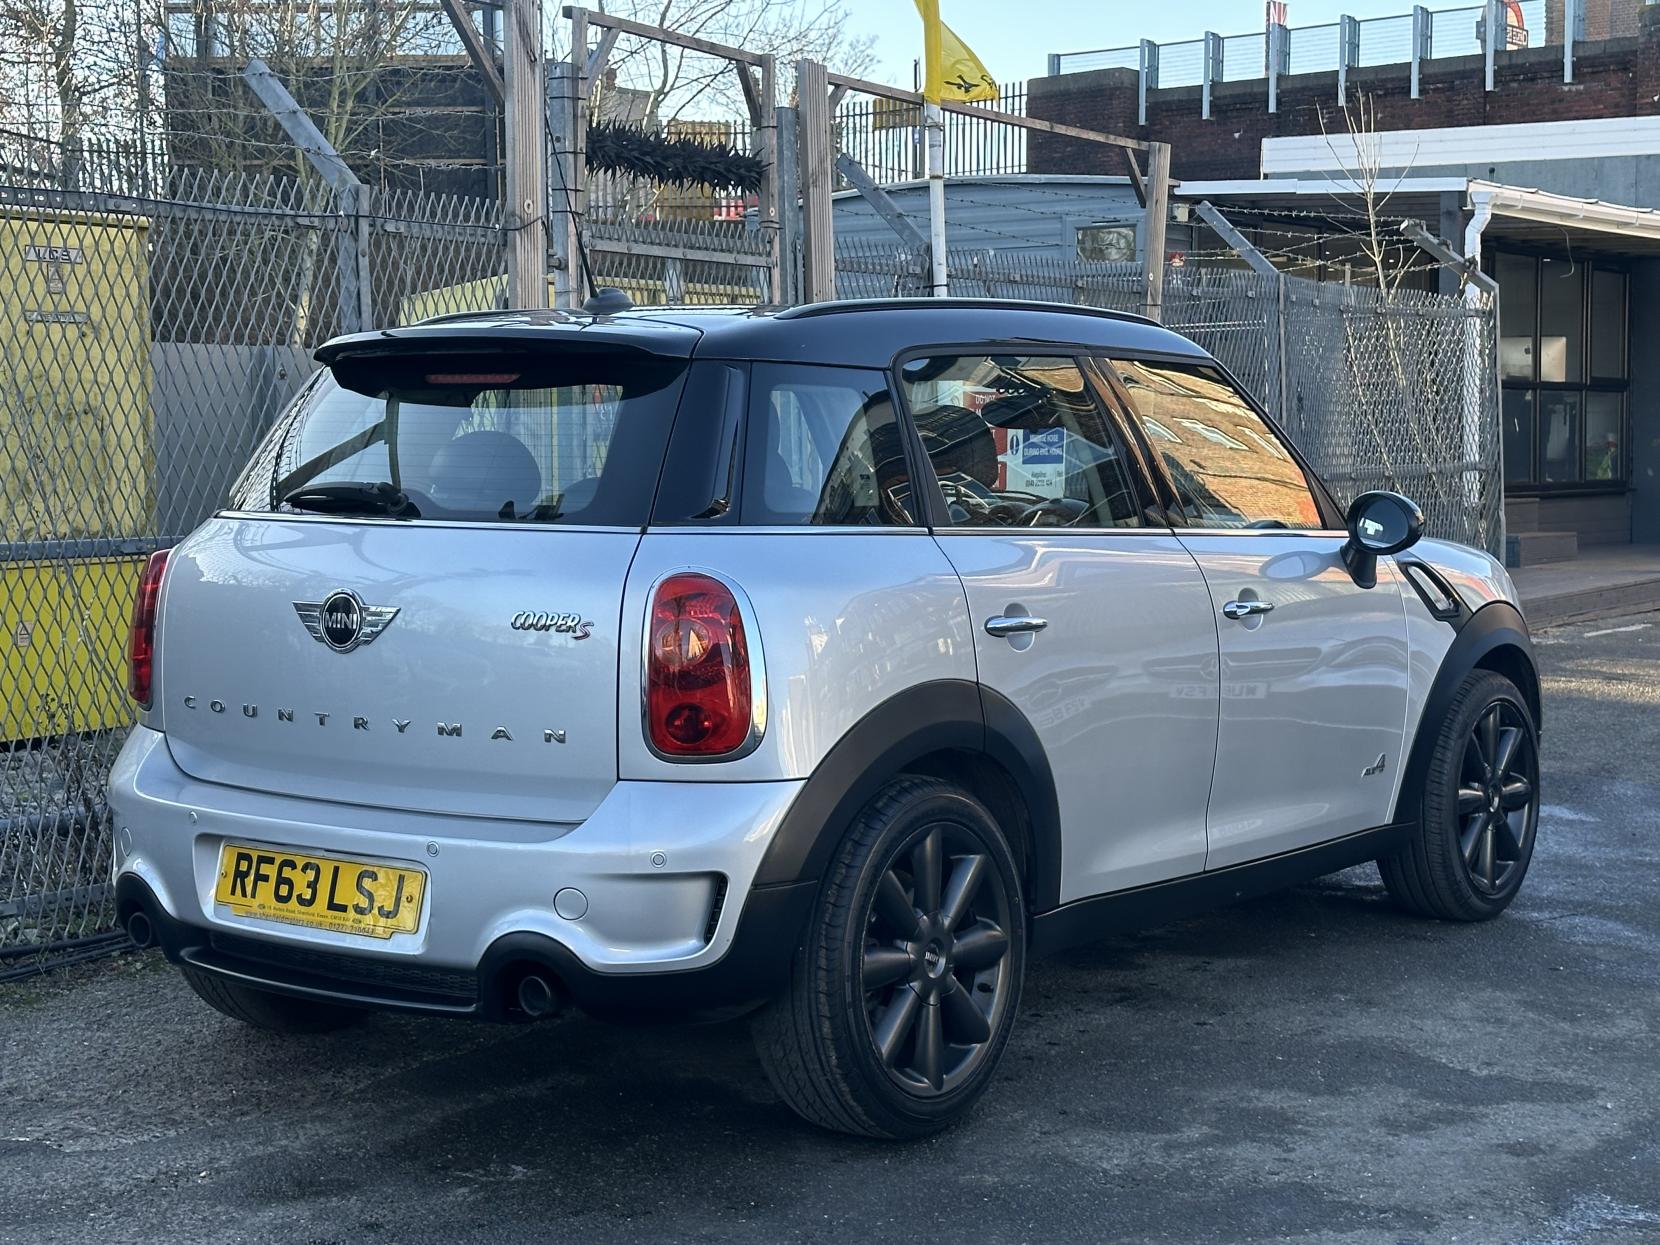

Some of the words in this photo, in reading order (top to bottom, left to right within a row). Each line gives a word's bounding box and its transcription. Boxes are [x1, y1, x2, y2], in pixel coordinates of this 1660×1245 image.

[323, 611, 358, 630] MINI
[510, 610, 581, 633] COOPER
[571, 620, 594, 641] S
[183, 695, 567, 744] COUNTRYMAN
[229, 851, 321, 908] RF63
[326, 865, 406, 920] LSJ
